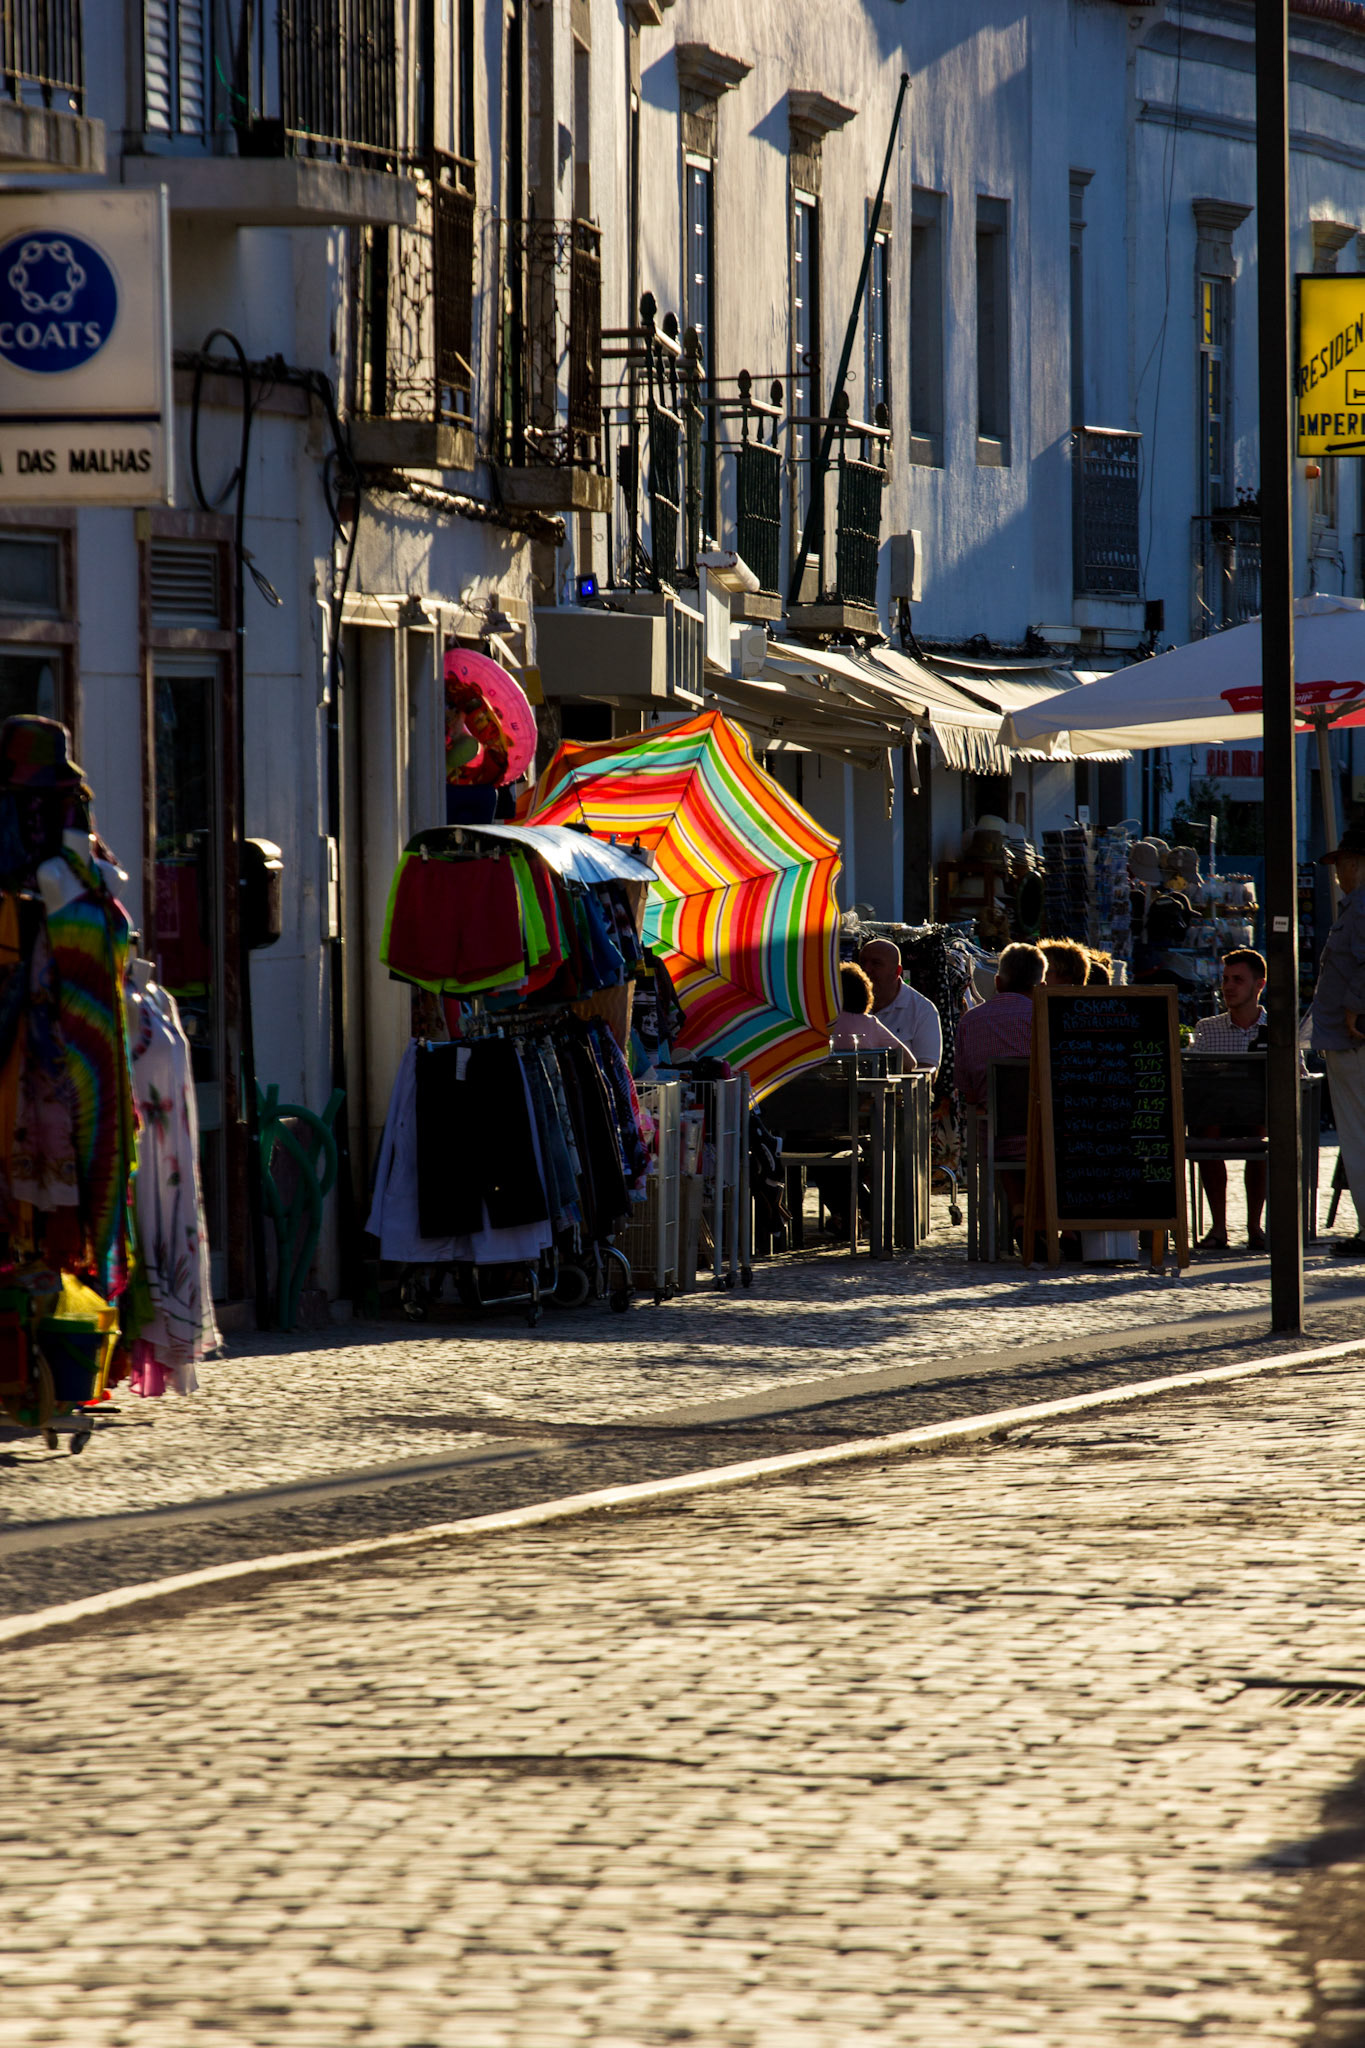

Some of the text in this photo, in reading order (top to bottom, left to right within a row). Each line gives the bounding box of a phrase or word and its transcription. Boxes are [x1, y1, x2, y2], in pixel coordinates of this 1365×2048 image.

[0, 321, 101, 349] COATS
[17, 449, 56, 473] DAS
[69, 449, 152, 473] MALHAS
